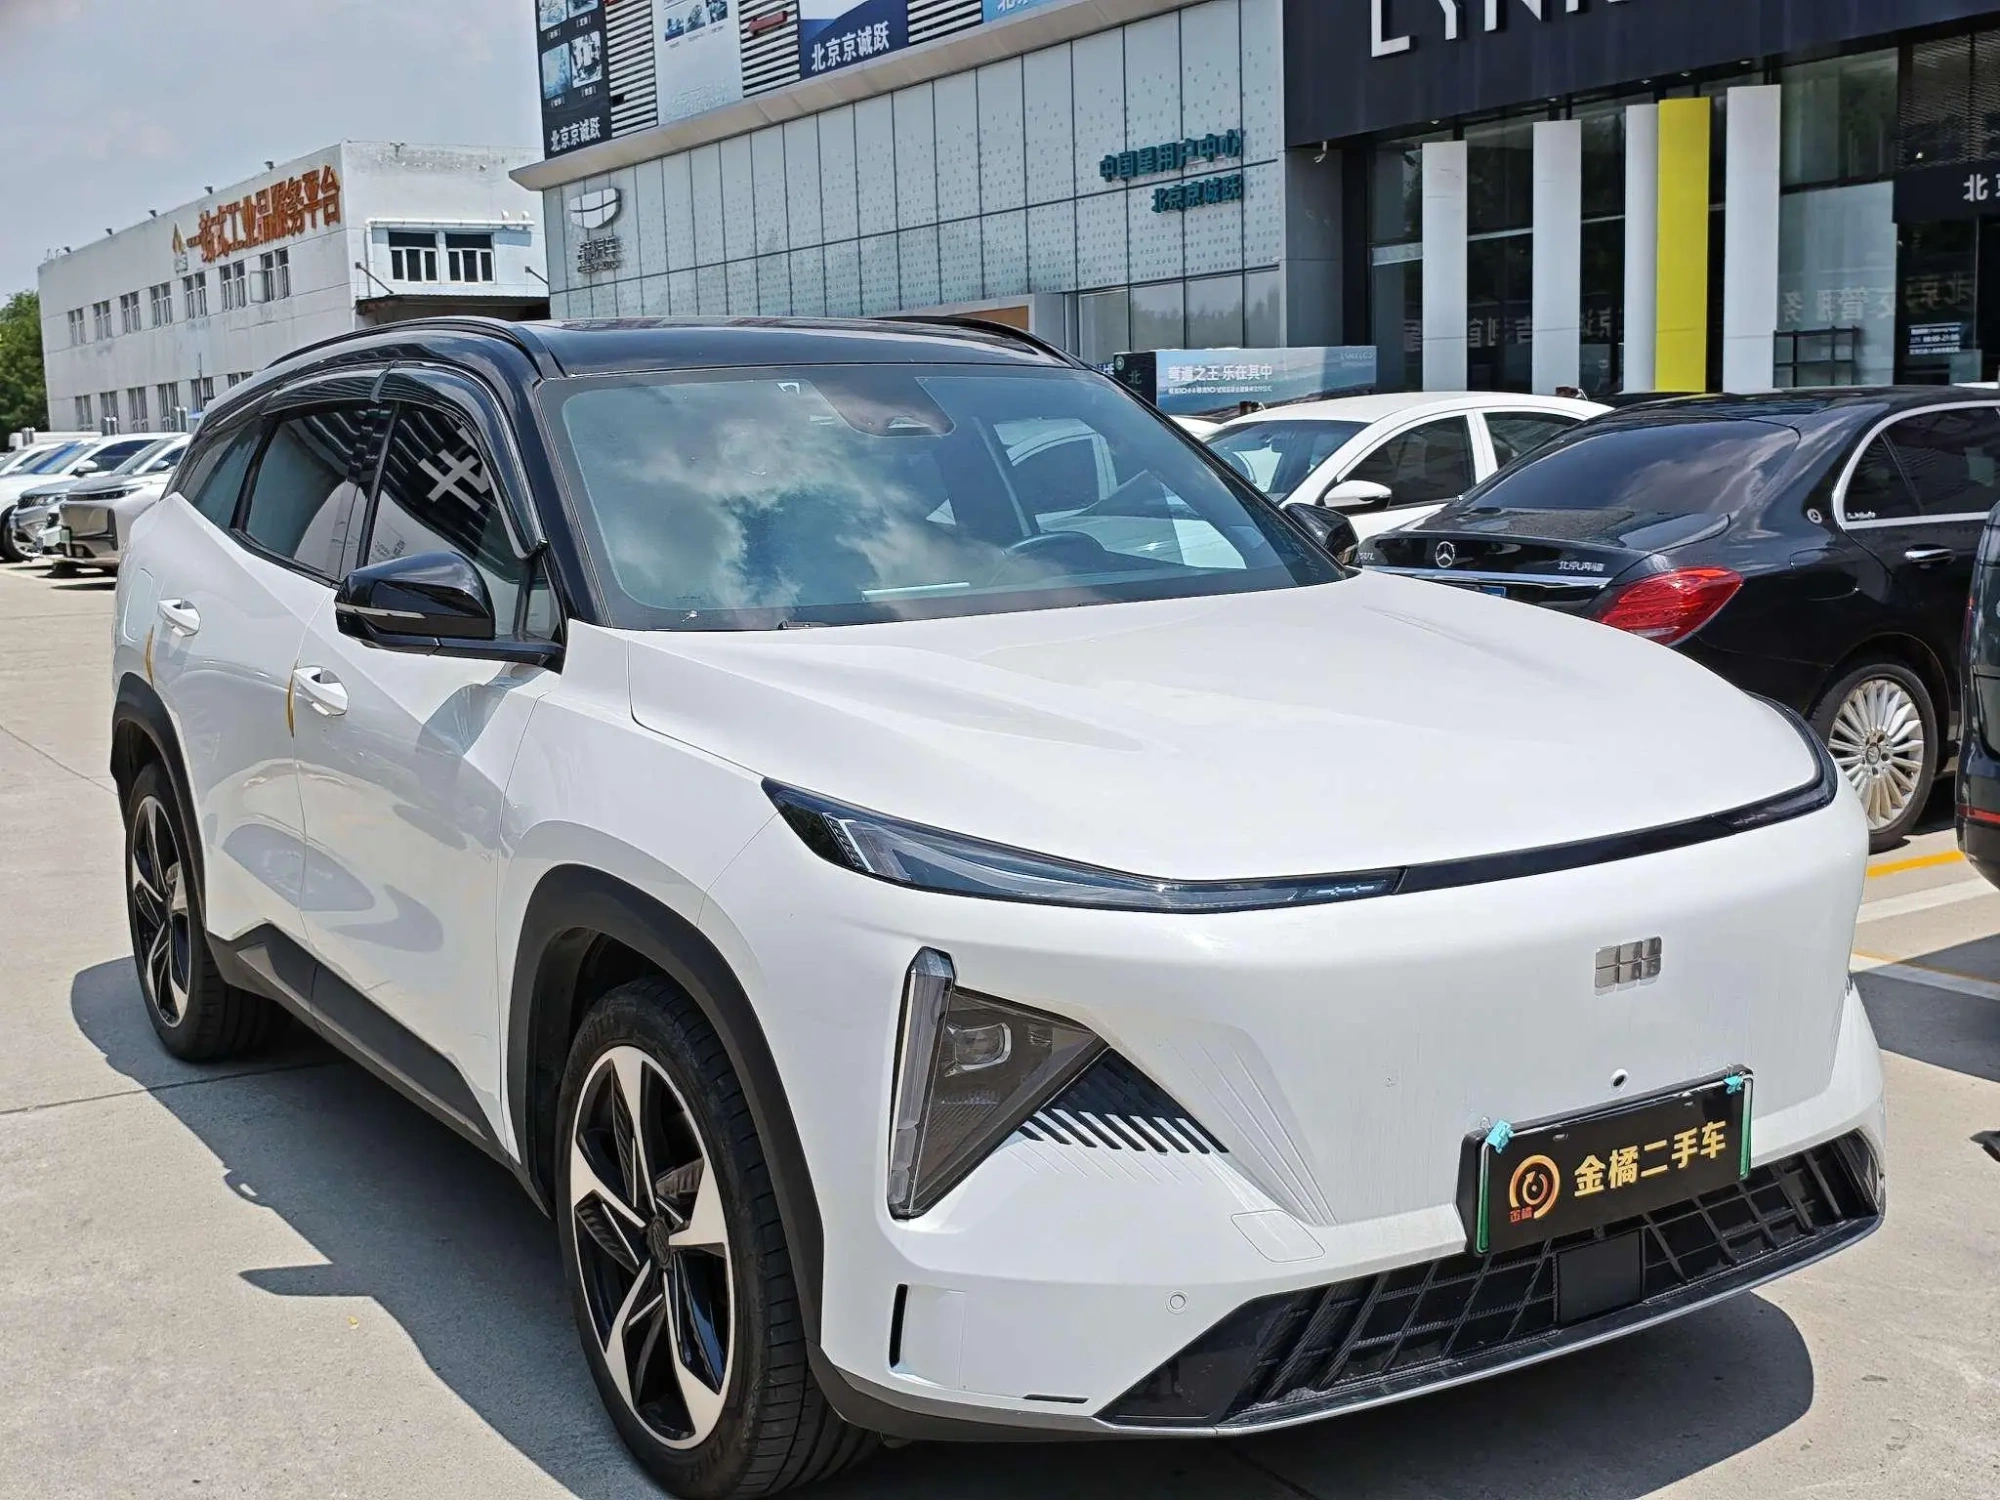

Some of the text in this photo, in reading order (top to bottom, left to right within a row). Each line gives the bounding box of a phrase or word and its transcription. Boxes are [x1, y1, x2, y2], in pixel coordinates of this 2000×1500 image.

[811, 21, 889, 72] 北京京诚跃
[1371, 0, 1632, 58] LY
[1100, 129, 1242, 182] 中国星用户中心
[1963, 173, 2000, 202] 北
[1574, 1120, 1727, 1197] 金橘二手车
